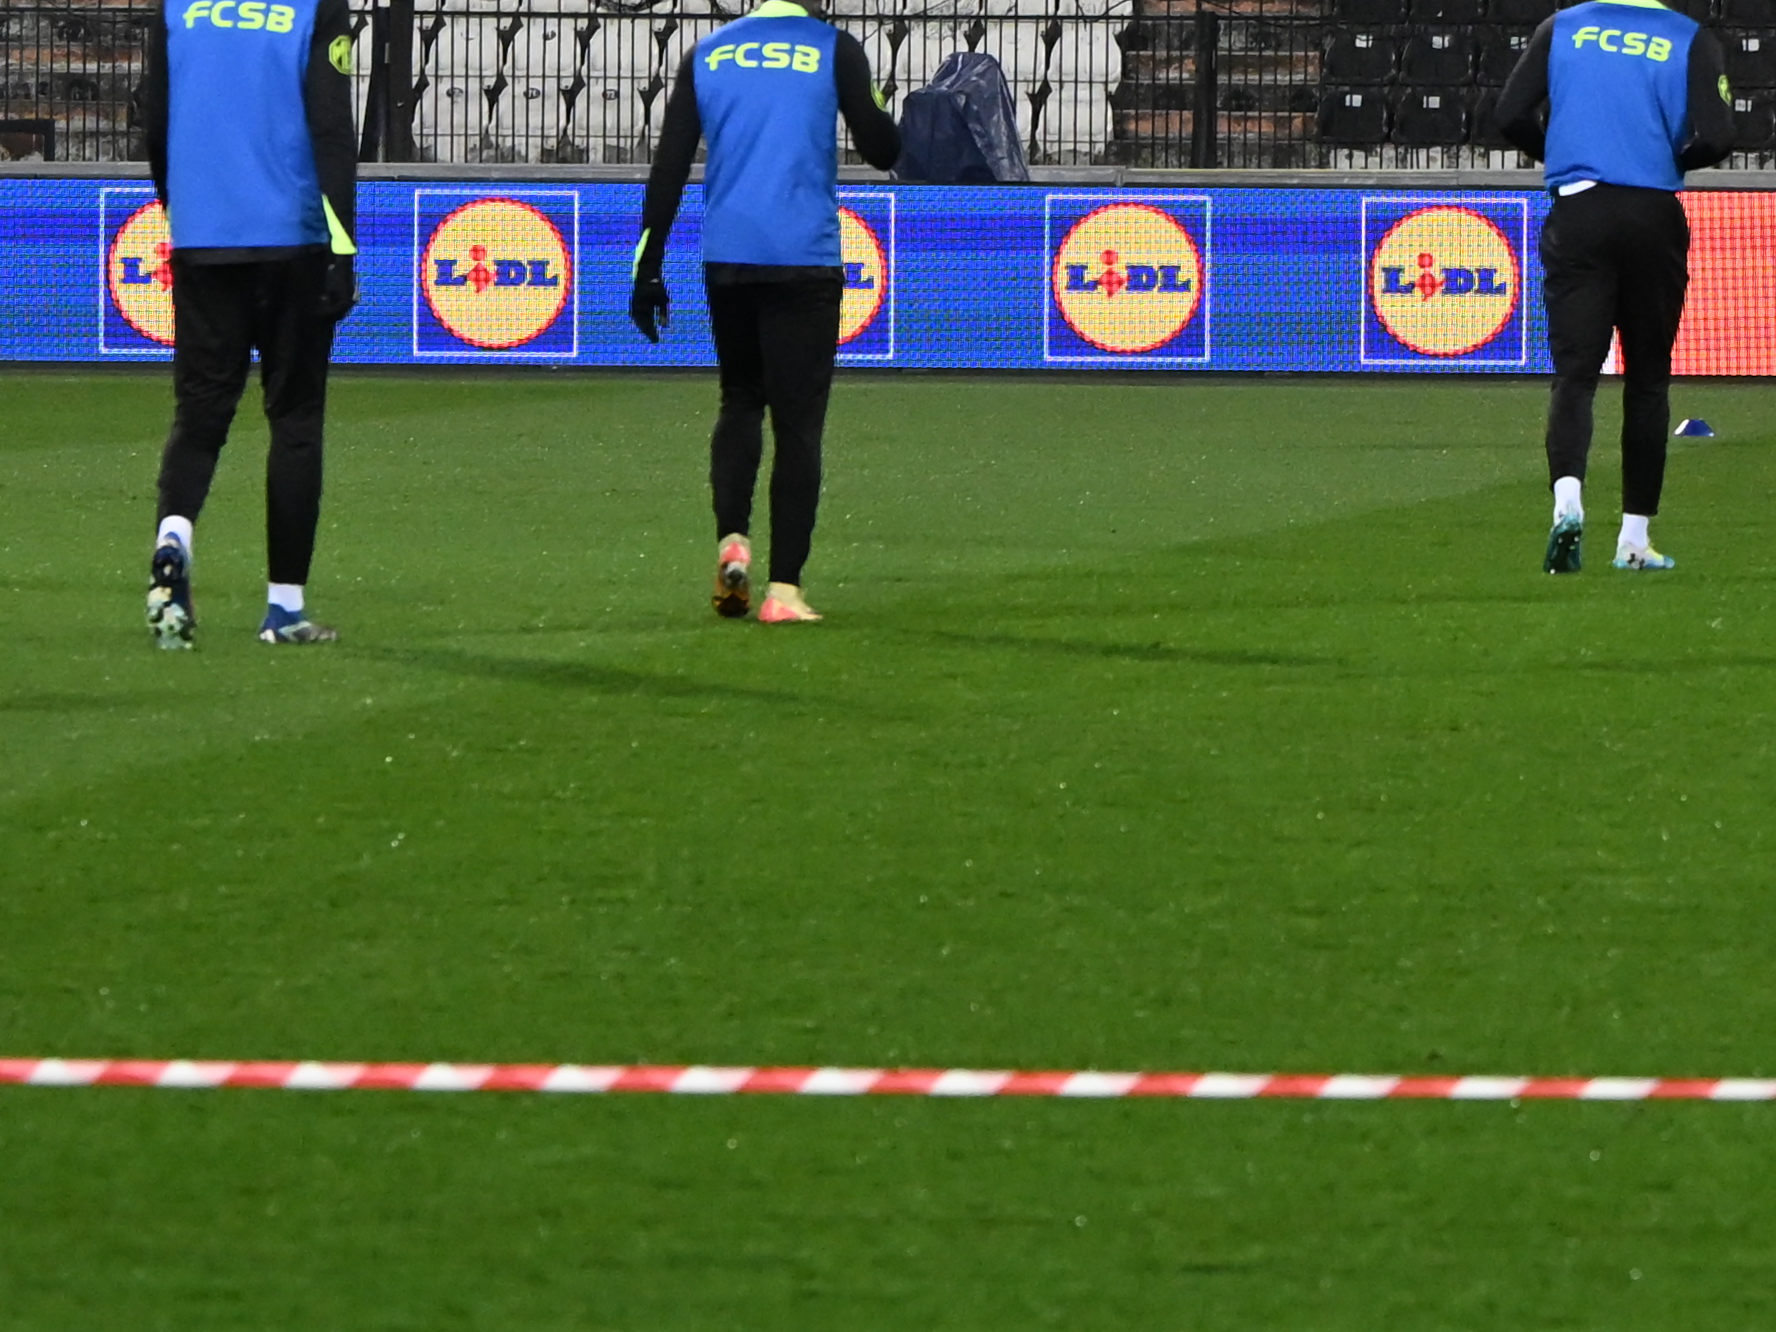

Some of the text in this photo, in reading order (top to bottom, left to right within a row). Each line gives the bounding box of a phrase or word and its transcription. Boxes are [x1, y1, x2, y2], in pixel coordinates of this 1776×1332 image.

[183, 0, 294, 33] FCSB
[705, 42, 821, 73] FCSB
[1572, 26, 1673, 63] FCSB
